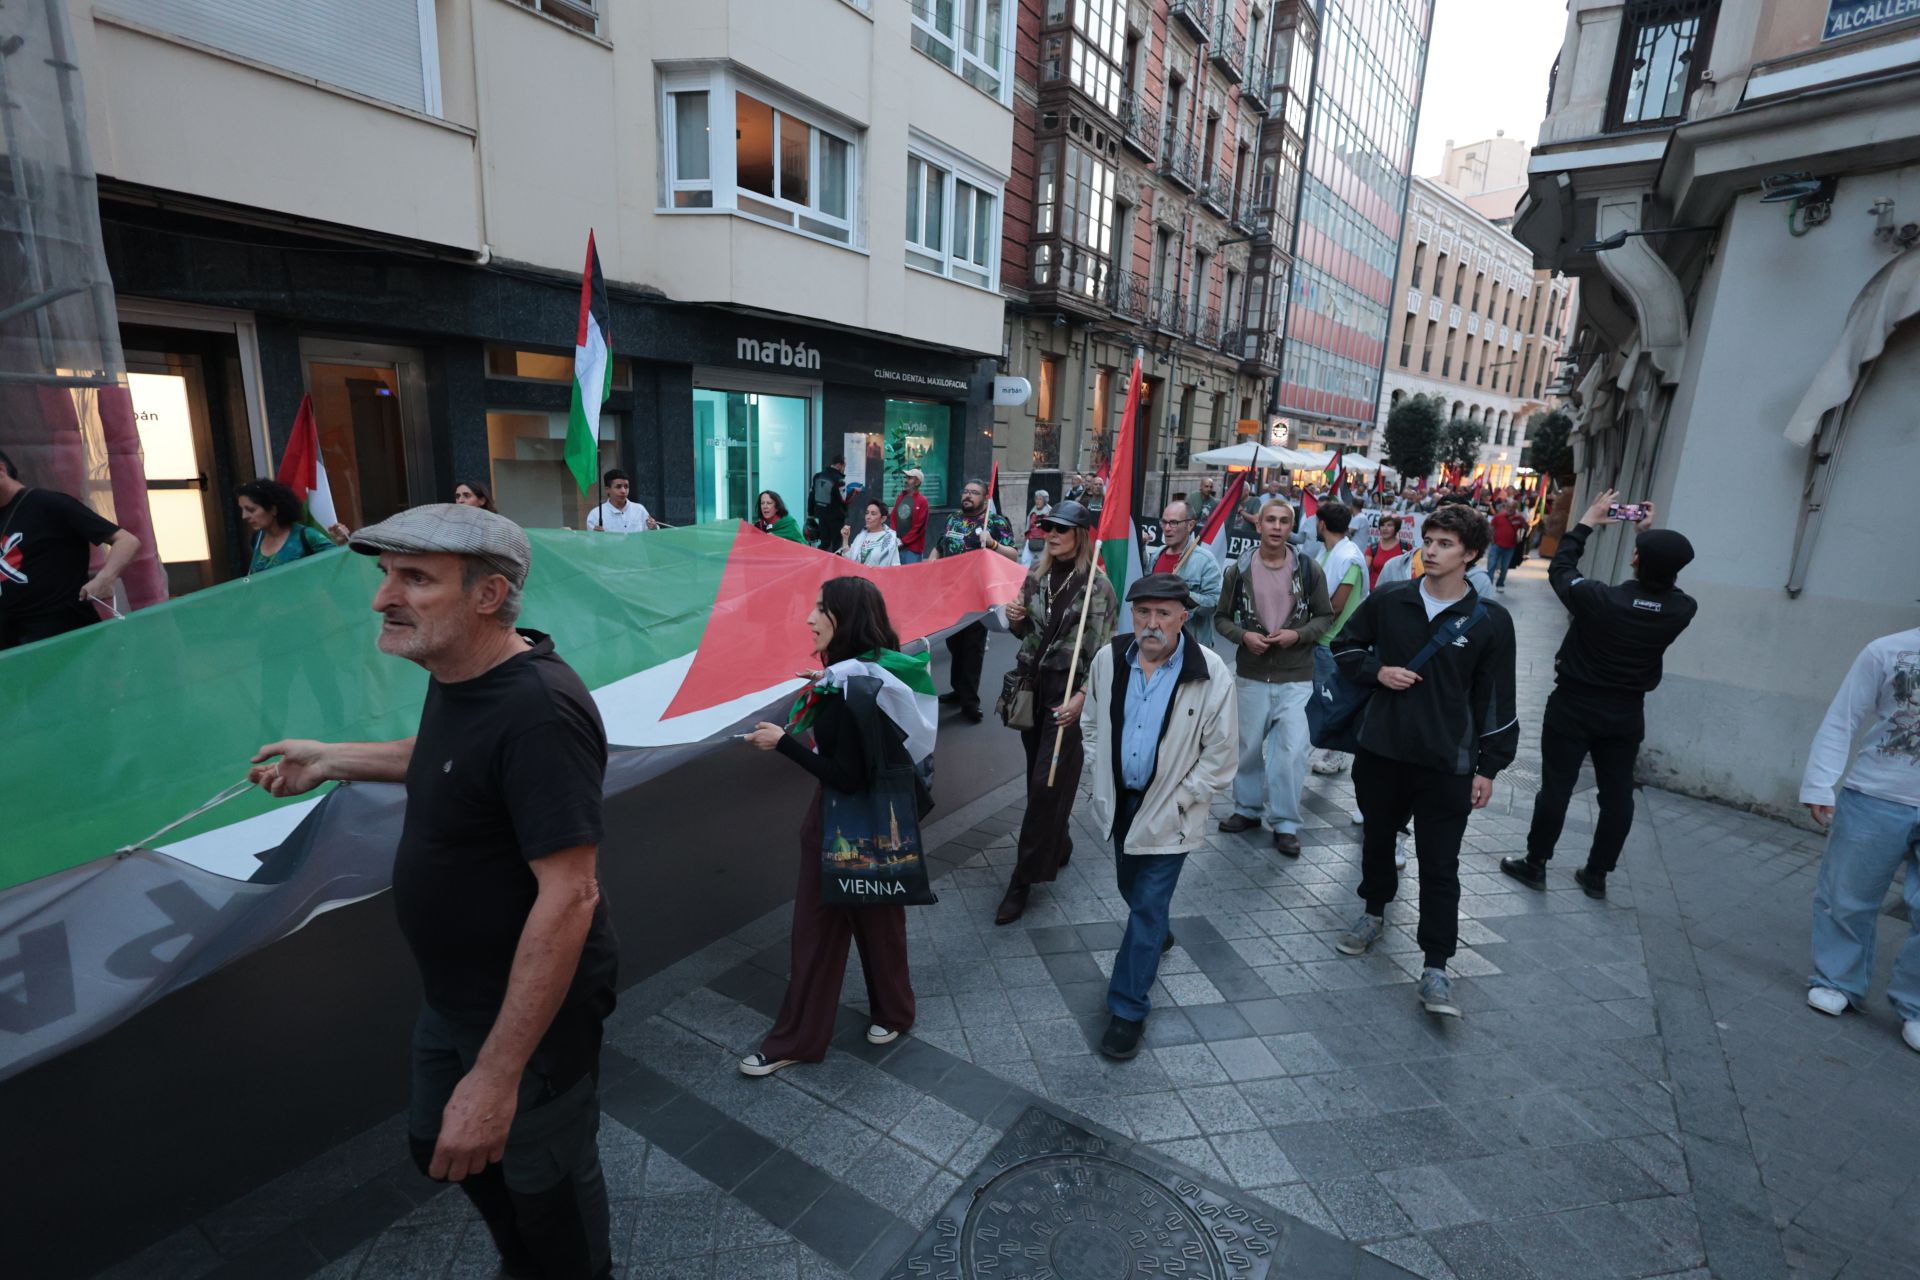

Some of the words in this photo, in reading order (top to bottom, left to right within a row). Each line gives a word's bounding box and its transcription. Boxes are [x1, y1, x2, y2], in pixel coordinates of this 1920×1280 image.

[1831, 0, 1920, 33] ALCALLER
[737, 337, 821, 370] marbán
[874, 368, 901, 381] CLÍNICA
[902, 373, 926, 384] DENTAL
[927, 377, 968, 390] MAXILOFACIAL
[838, 878, 906, 895] VIENNA
